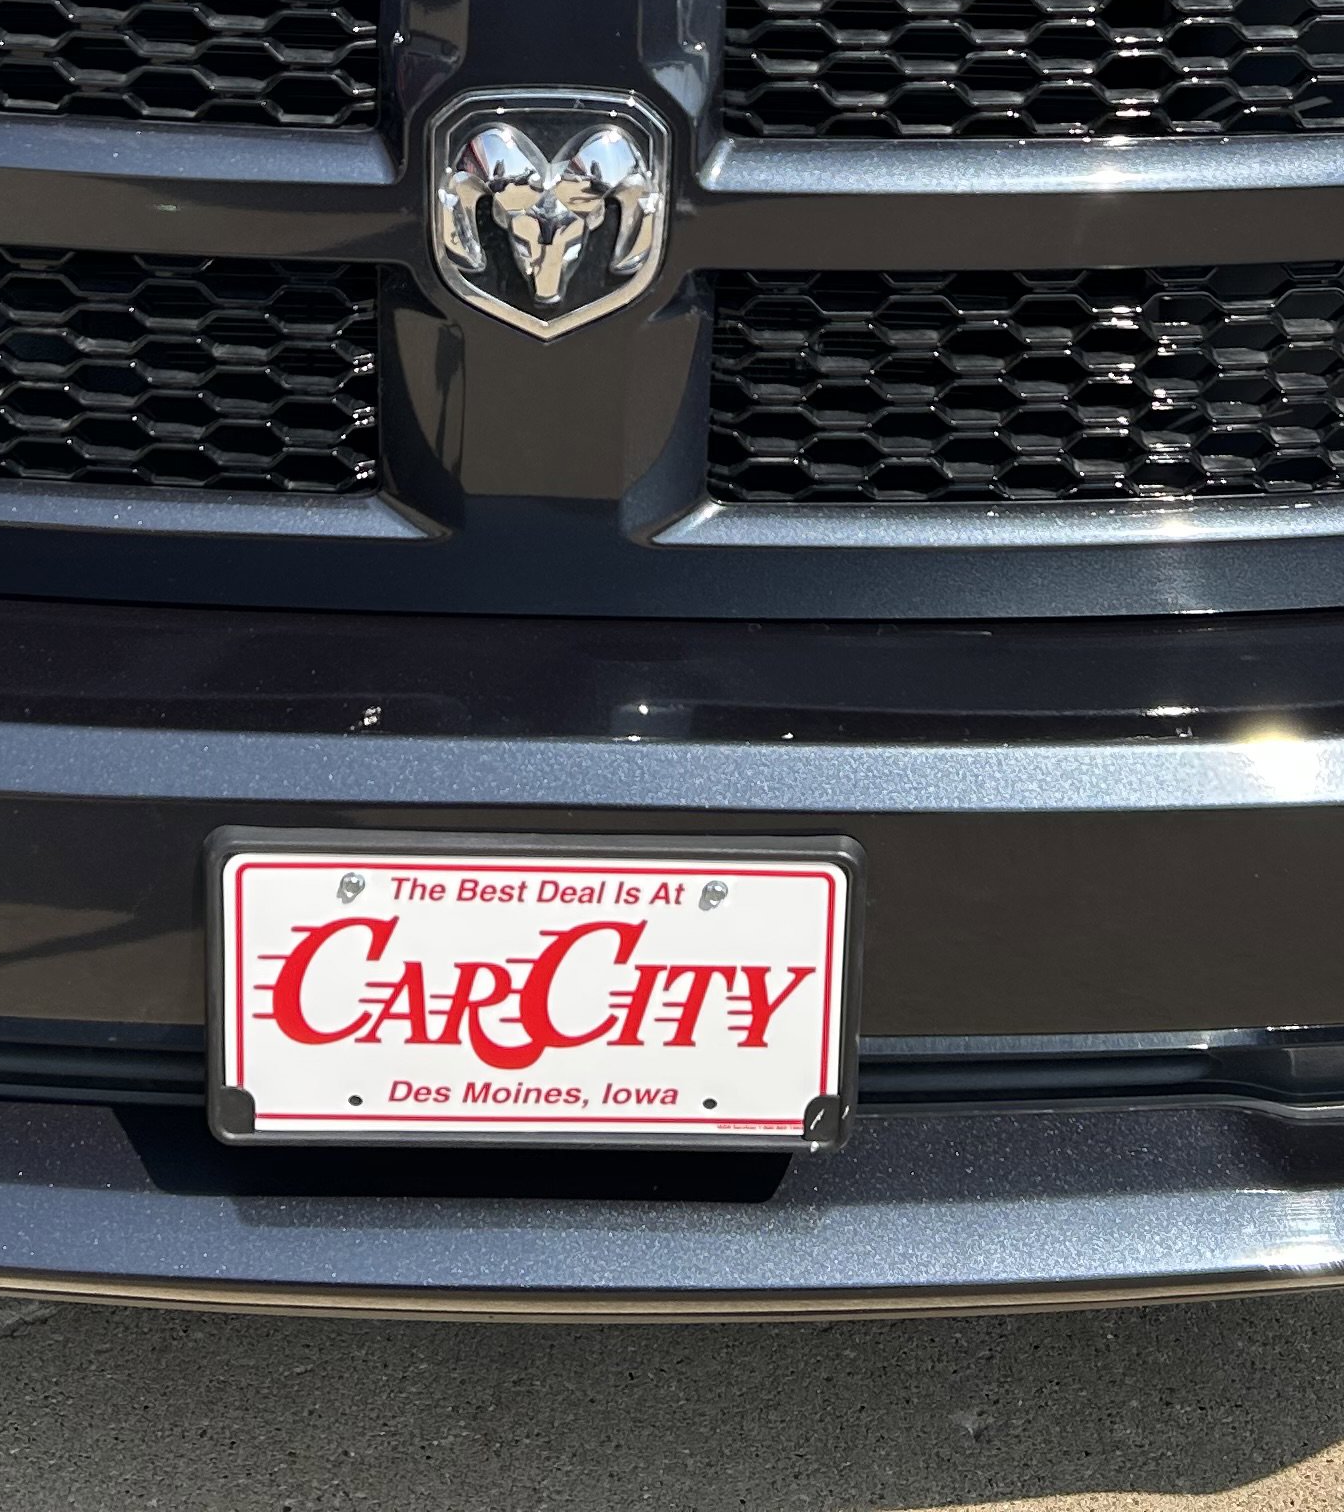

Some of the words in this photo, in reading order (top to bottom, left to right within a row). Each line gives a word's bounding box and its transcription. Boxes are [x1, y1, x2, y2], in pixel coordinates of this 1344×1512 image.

[391, 876, 446, 901] The
[455, 877, 528, 903] Best
[536, 879, 606, 905] Deal
[613, 880, 642, 905] Is
[648, 881, 686, 906] At
[388, 1079, 452, 1103] Des
[461, 1081, 590, 1109] Moines,
[601, 1082, 679, 1105] Iowa
